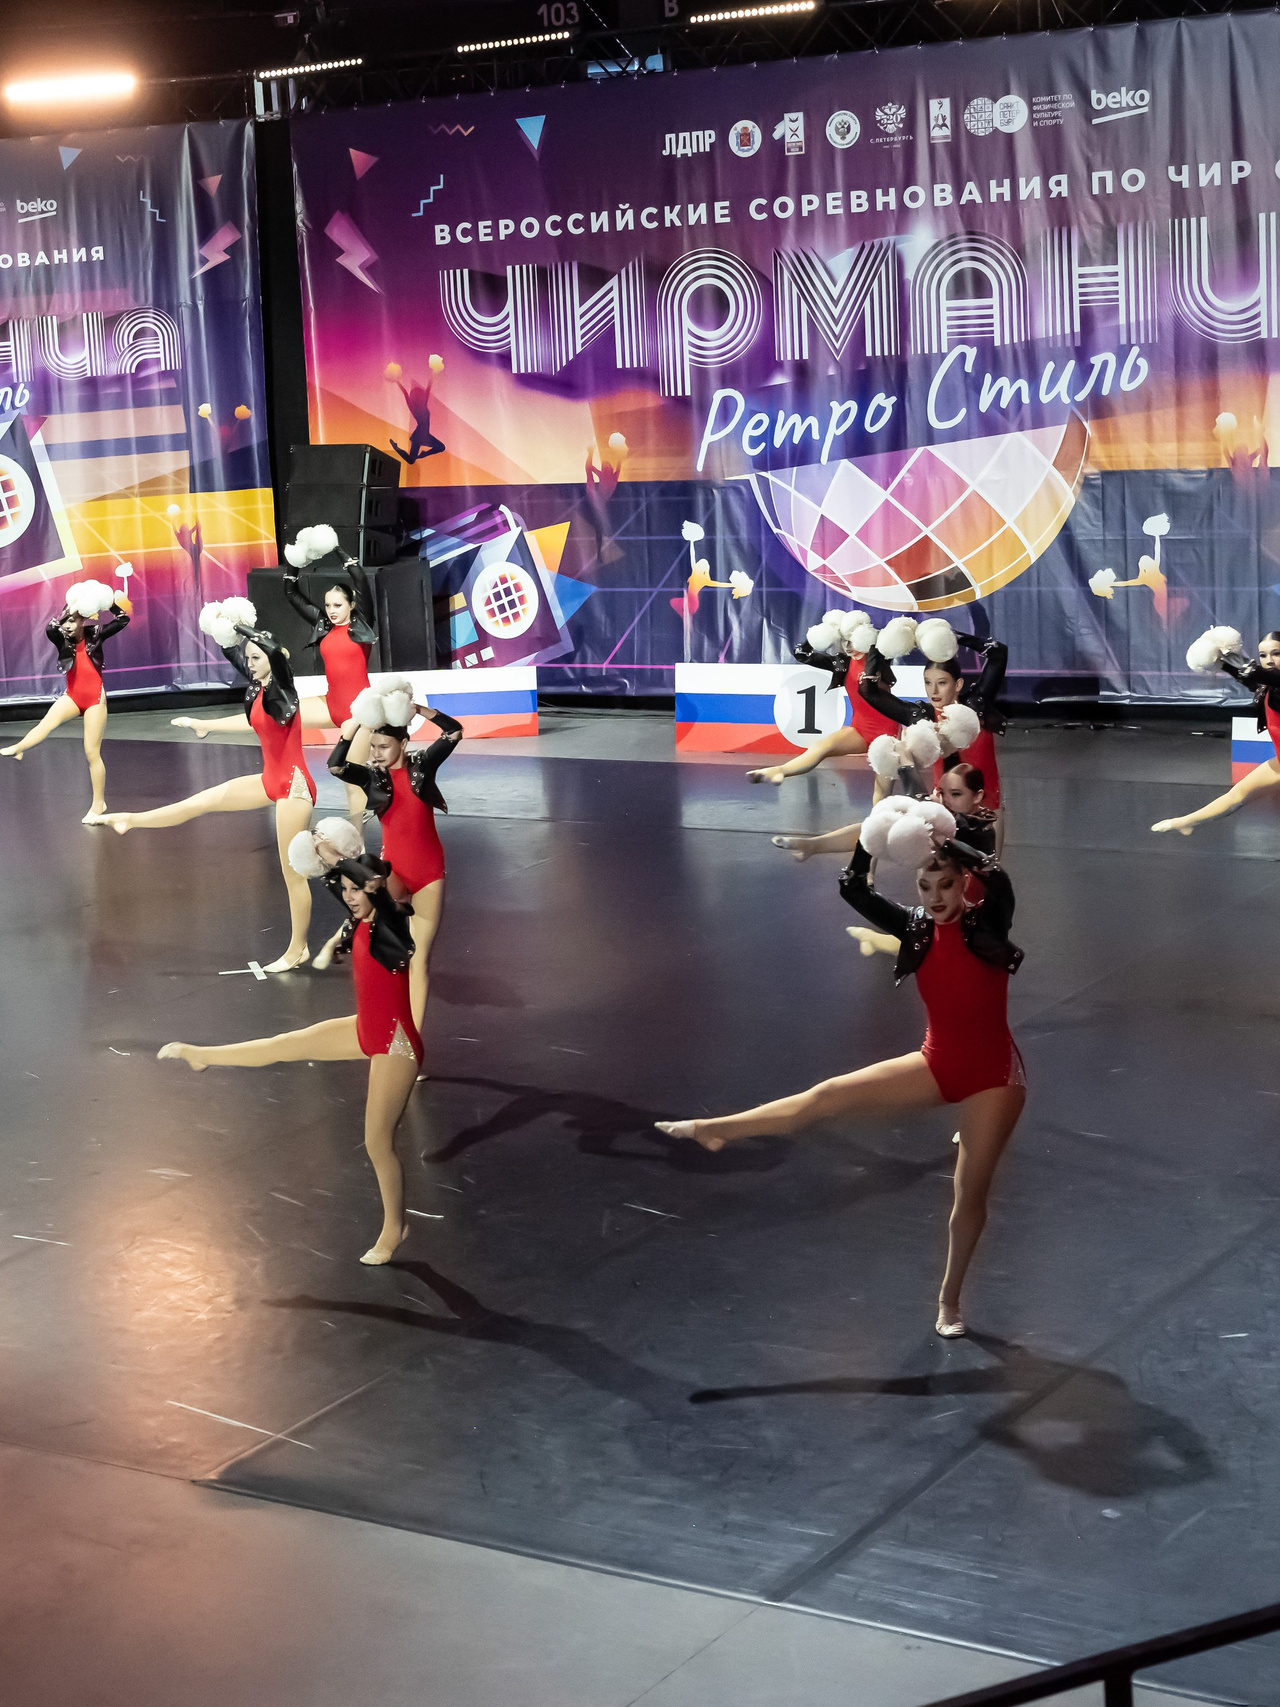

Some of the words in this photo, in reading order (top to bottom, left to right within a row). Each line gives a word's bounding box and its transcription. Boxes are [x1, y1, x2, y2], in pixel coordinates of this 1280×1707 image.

[537, 2, 580, 27] 103
[1032, 95, 1061, 103] КОМИТЕТ
[1032, 101, 1076, 111] ФИЗИЧЕСКОЙ
[1090, 86, 1151, 111] beko
[1032, 111, 1062, 119] КУЛЬТУРЕ
[1039, 118, 1064, 127] СПОРТУ
[662, 130, 716, 158] ЛДПР
[16, 198, 58, 214] beko
[434, 201, 732, 246] ВСЕРОССИЙСКИЕ
[748, 173, 1069, 222] СОРЕВНОВАНИЯ
[1091, 169, 1146, 196] ПО
[1167, 160, 1253, 189] ЧИР
[696, 388, 898, 473] Ретро
[927, 345, 1149, 431] Стиль
[796, 685, 823, 735] 1
